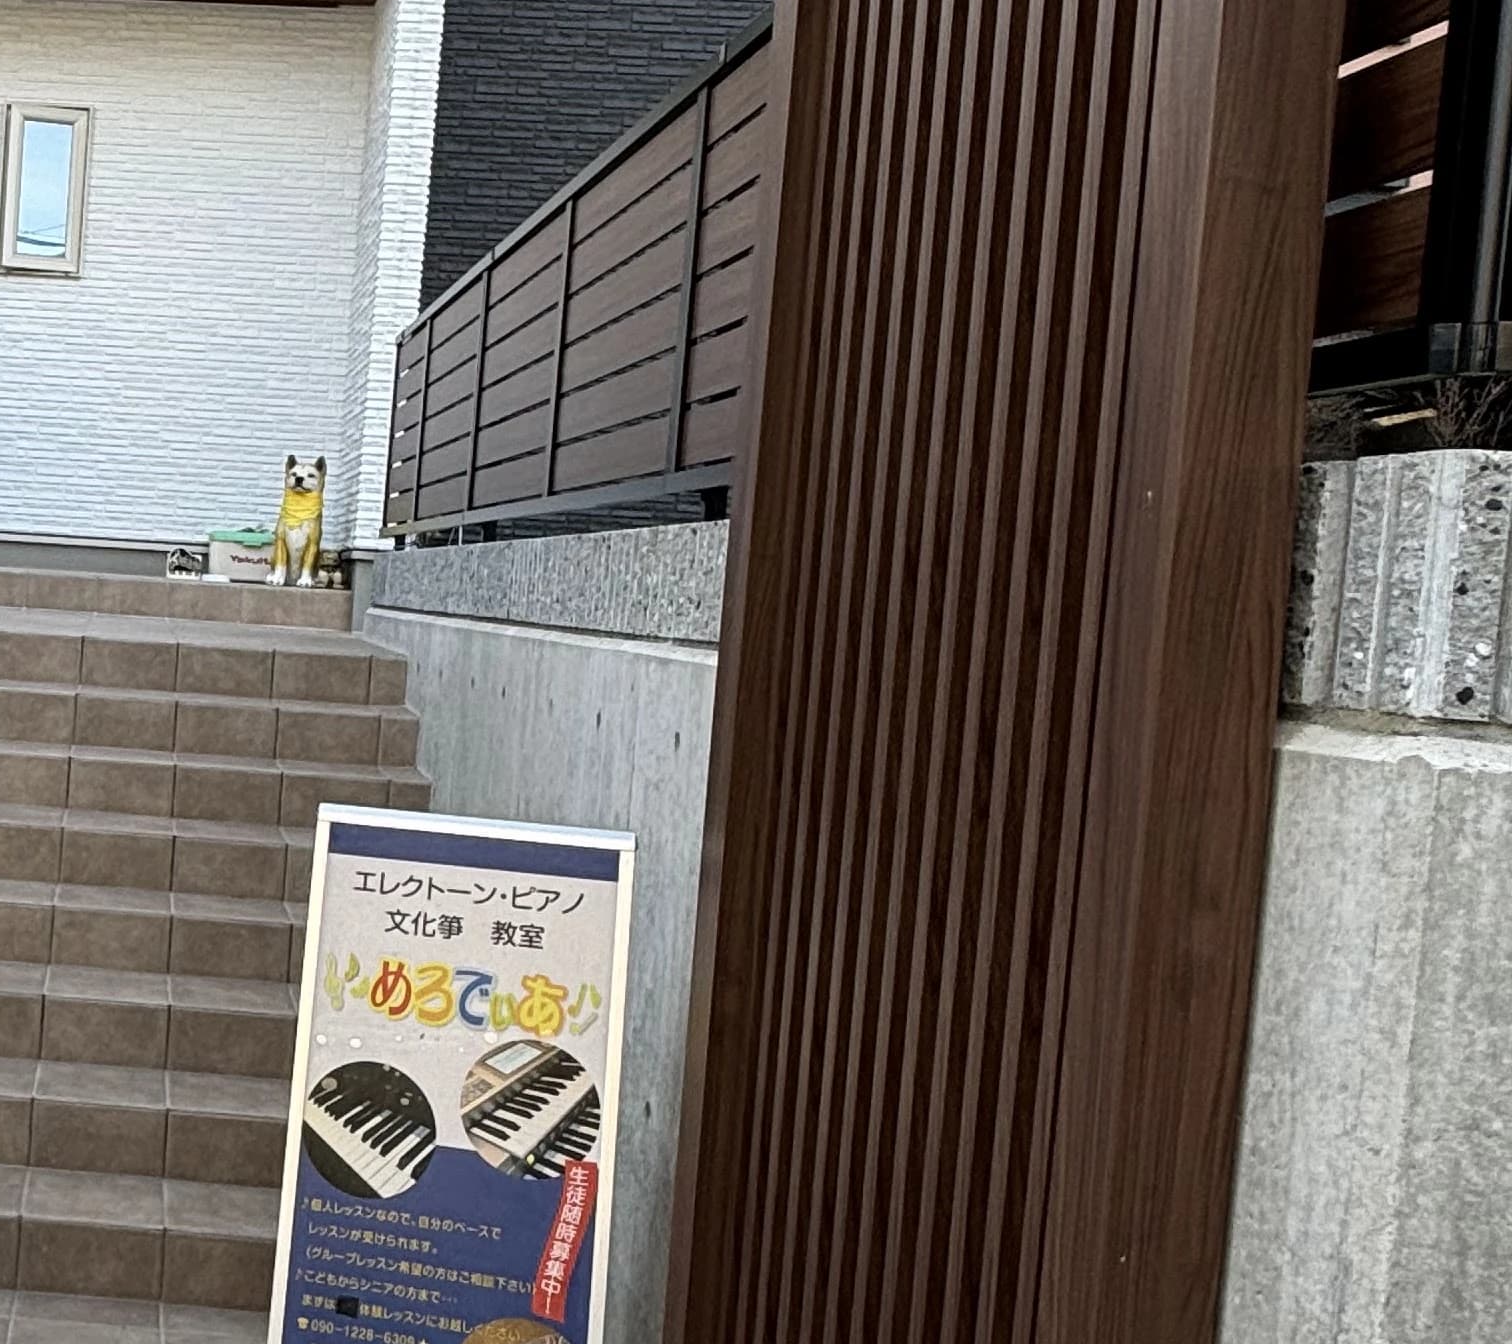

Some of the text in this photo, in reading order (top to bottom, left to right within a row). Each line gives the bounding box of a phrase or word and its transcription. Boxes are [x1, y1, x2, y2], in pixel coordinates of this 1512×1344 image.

[352, 870, 585, 915] エレクトーン・ピアノ
[491, 920, 546, 950] 教室
